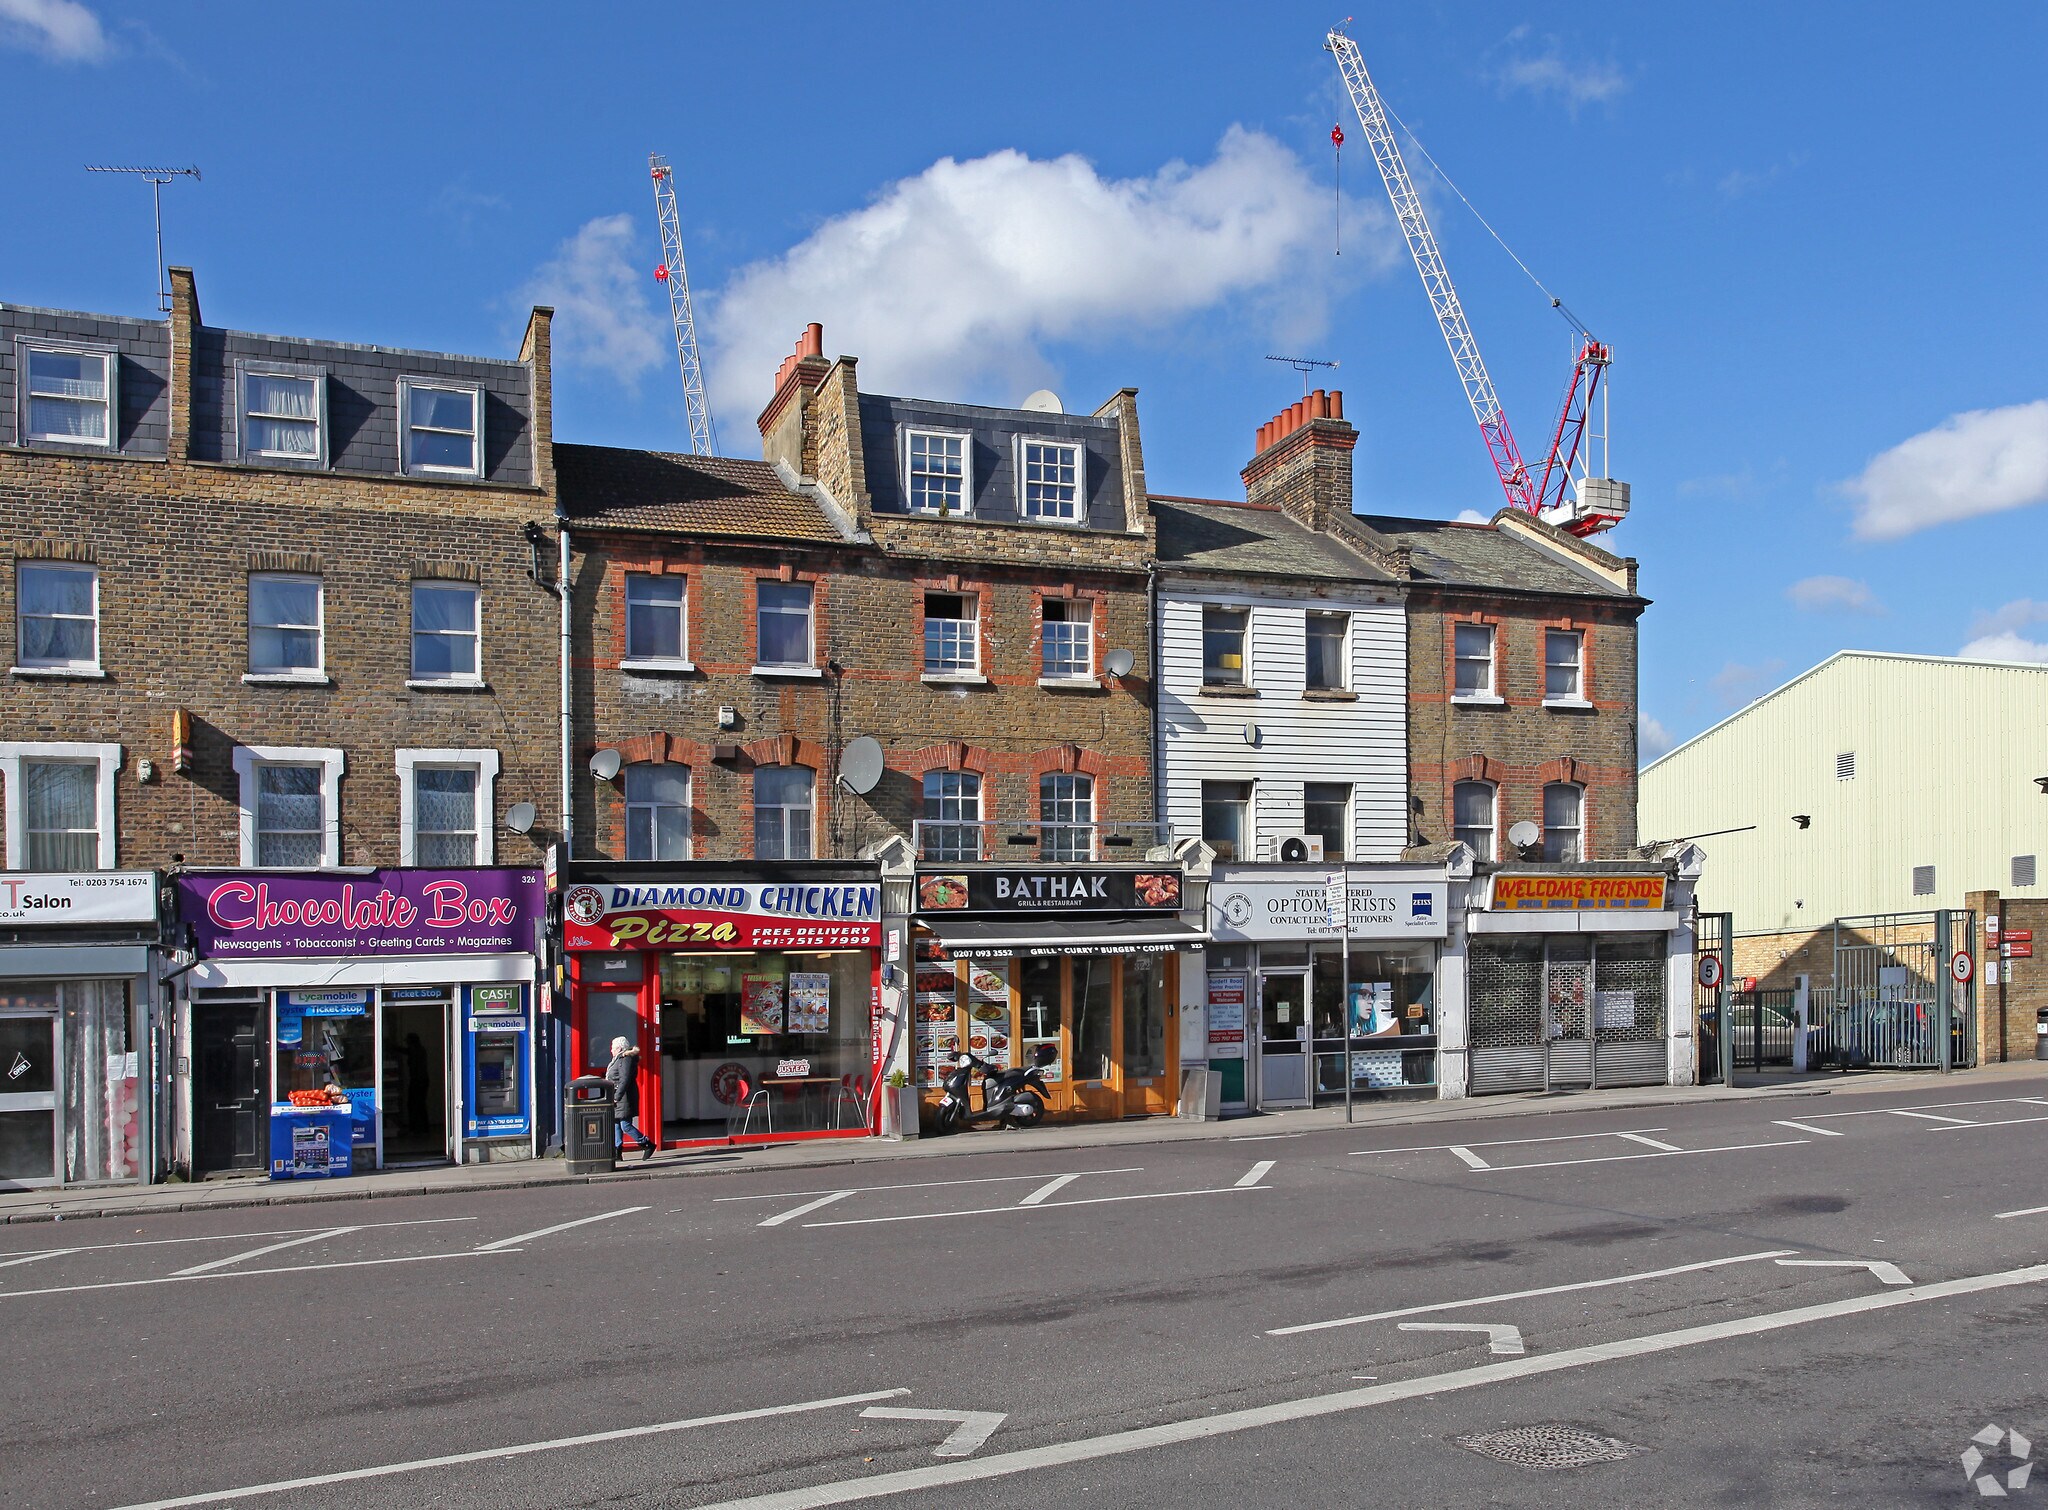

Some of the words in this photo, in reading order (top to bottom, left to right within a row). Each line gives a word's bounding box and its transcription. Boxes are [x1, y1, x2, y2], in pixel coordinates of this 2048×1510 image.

[69, 879, 84, 887] Tel:
[86, 879, 107, 887] 0203
[109, 879, 125, 887] 754
[127, 878, 148, 886] 1674
[521, 875, 536, 883] 326
[996, 876, 1108, 898] BATHAK
[1498, 880, 1585, 898] WELCOME
[1590, 880, 1663, 898] FRIENDS
[1295, 889, 1320, 897] STATE
[23, 893, 72, 909] Salon
[207, 880, 418, 930] Chocolate
[422, 879, 517, 929] Box
[611, 887, 745, 909] DIAMOND
[760, 887, 876, 917] CHICKEN
[1270, 916, 1308, 925] CONTACT
[610, 917, 737, 947] Pizza
[752, 928, 792, 936] FREE
[796, 927, 871, 935] DELIVERY
[214, 939, 282, 951] Newsagents
[294, 938, 357, 948] Tobacconist
[368, 937, 412, 949] Greeting
[415, 936, 445, 947] Cards
[457, 936, 512, 948] Magazines
[830, 937, 871, 945] 7999
[953, 950, 973, 958] 0207
[976, 949, 991, 957] 093
[993, 949, 1013, 957] 3552
[1101, 946, 1136, 954] BURGER
[1142, 944, 1175, 952] COFFEE
[1705, 965, 1713, 978] 5
[1958, 961, 1965, 973] 5
[298, 991, 358, 1002] Lycamobile
[421, 990, 442, 998] Stop
[479, 989, 513, 1000] CASH
[312, 1005, 339, 1013] Ticket
[341, 1004, 362, 1014] Stop
[473, 1021, 521, 1030] Lycamobile
[13, 1064, 27, 1076] OPEN
[345, 1090, 372, 1100] oyster
